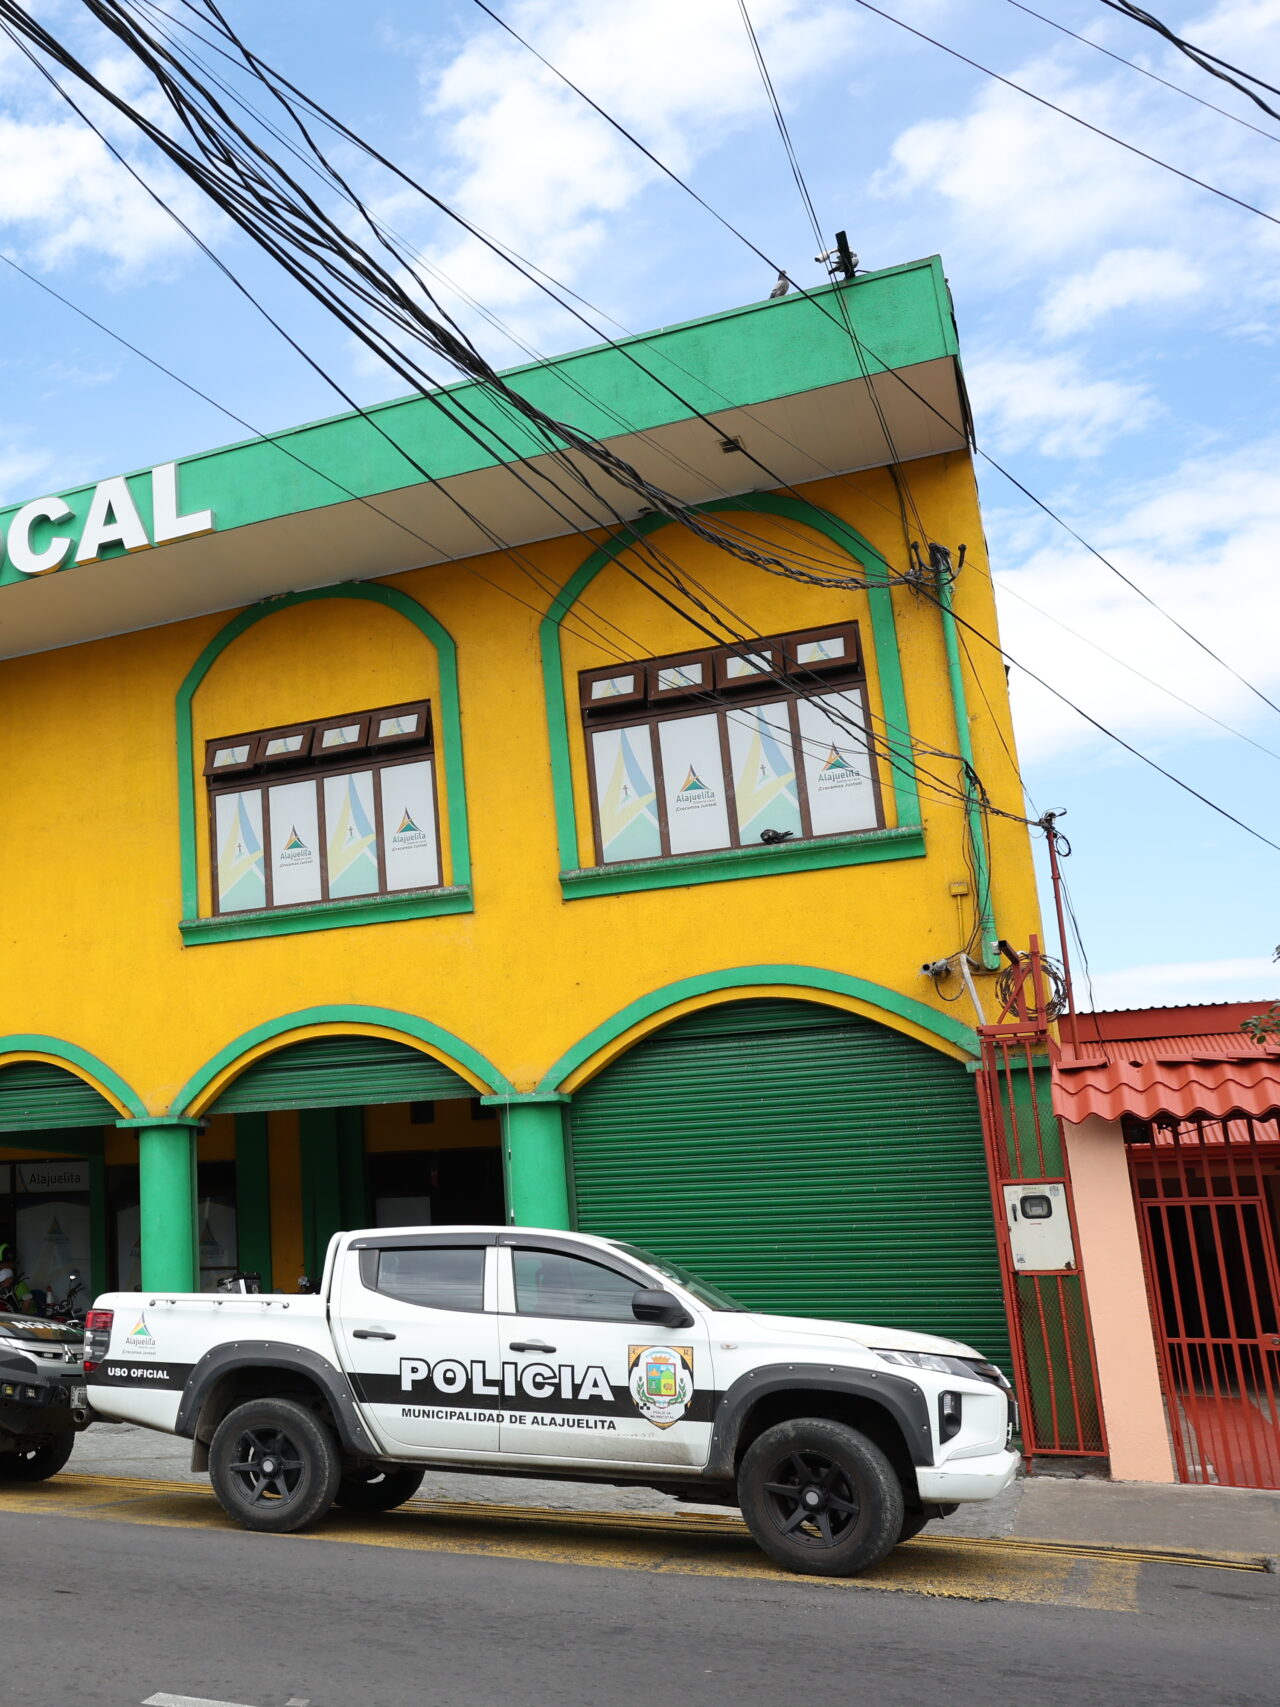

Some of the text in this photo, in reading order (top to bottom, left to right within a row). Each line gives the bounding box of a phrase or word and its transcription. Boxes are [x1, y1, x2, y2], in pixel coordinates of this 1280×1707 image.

[818, 769, 860, 782] Alajuelita
[676, 790, 715, 803] Alajuelita
[392, 832, 426, 844] Alajuelita
[280, 849, 312, 860] Alajuelita
[29, 1172, 81, 1187] Alajuelita
[125, 1337, 156, 1346] Alajuelita
[108, 1367, 170, 1379] USO OFICIAL
[399, 1357, 616, 1401] POLICIA
[401, 1408, 617, 1430] MUNICIPALIDAD DE ALAJUELITA
